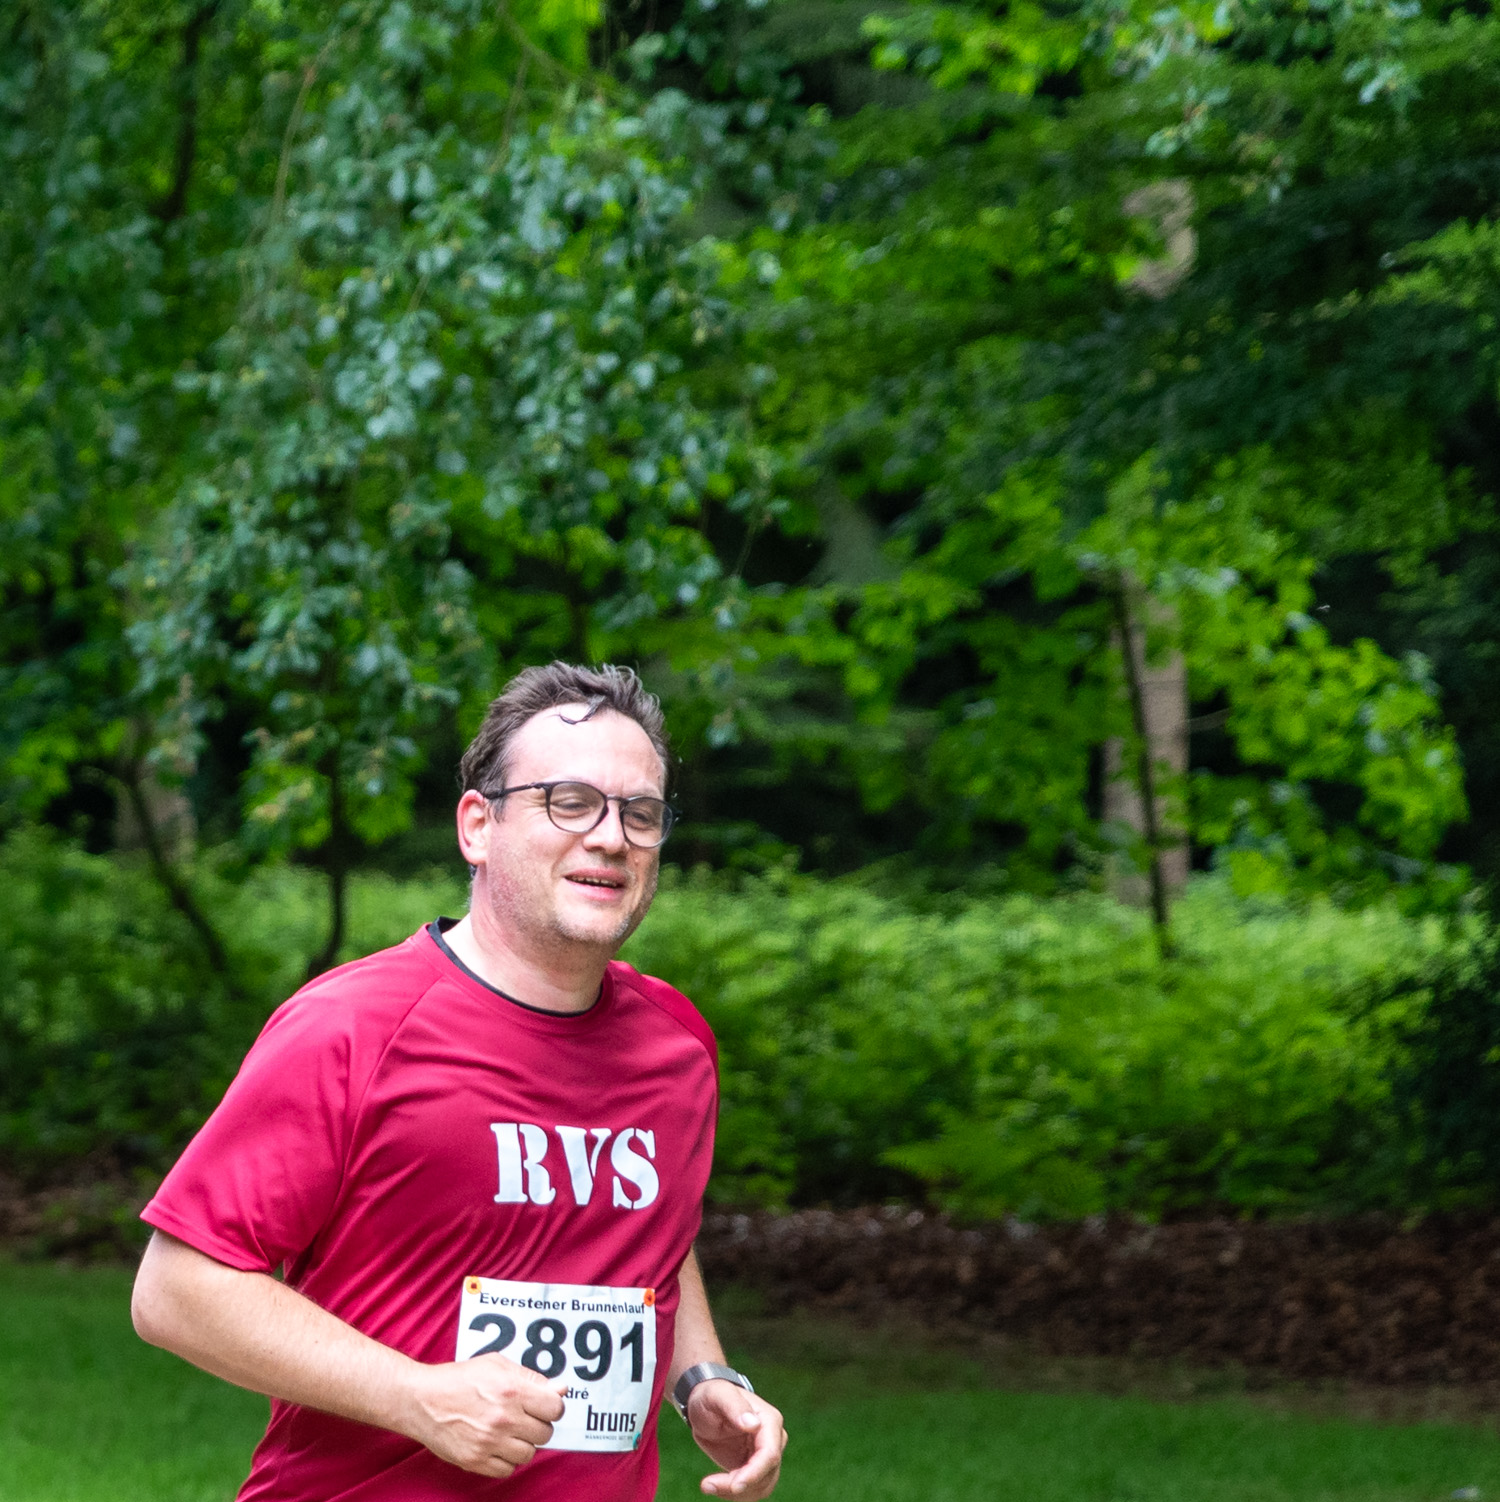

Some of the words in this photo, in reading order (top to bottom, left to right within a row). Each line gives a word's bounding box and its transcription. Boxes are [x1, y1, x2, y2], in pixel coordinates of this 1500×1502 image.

[489, 1122, 660, 1210] RVS
[479, 1292, 567, 1311] Everstener
[571, 1299, 646, 1314] Brunnenlauf
[468, 1312, 644, 1383] 2891
[565, 1387, 590, 1400] dré
[586, 1404, 638, 1433] bruns
